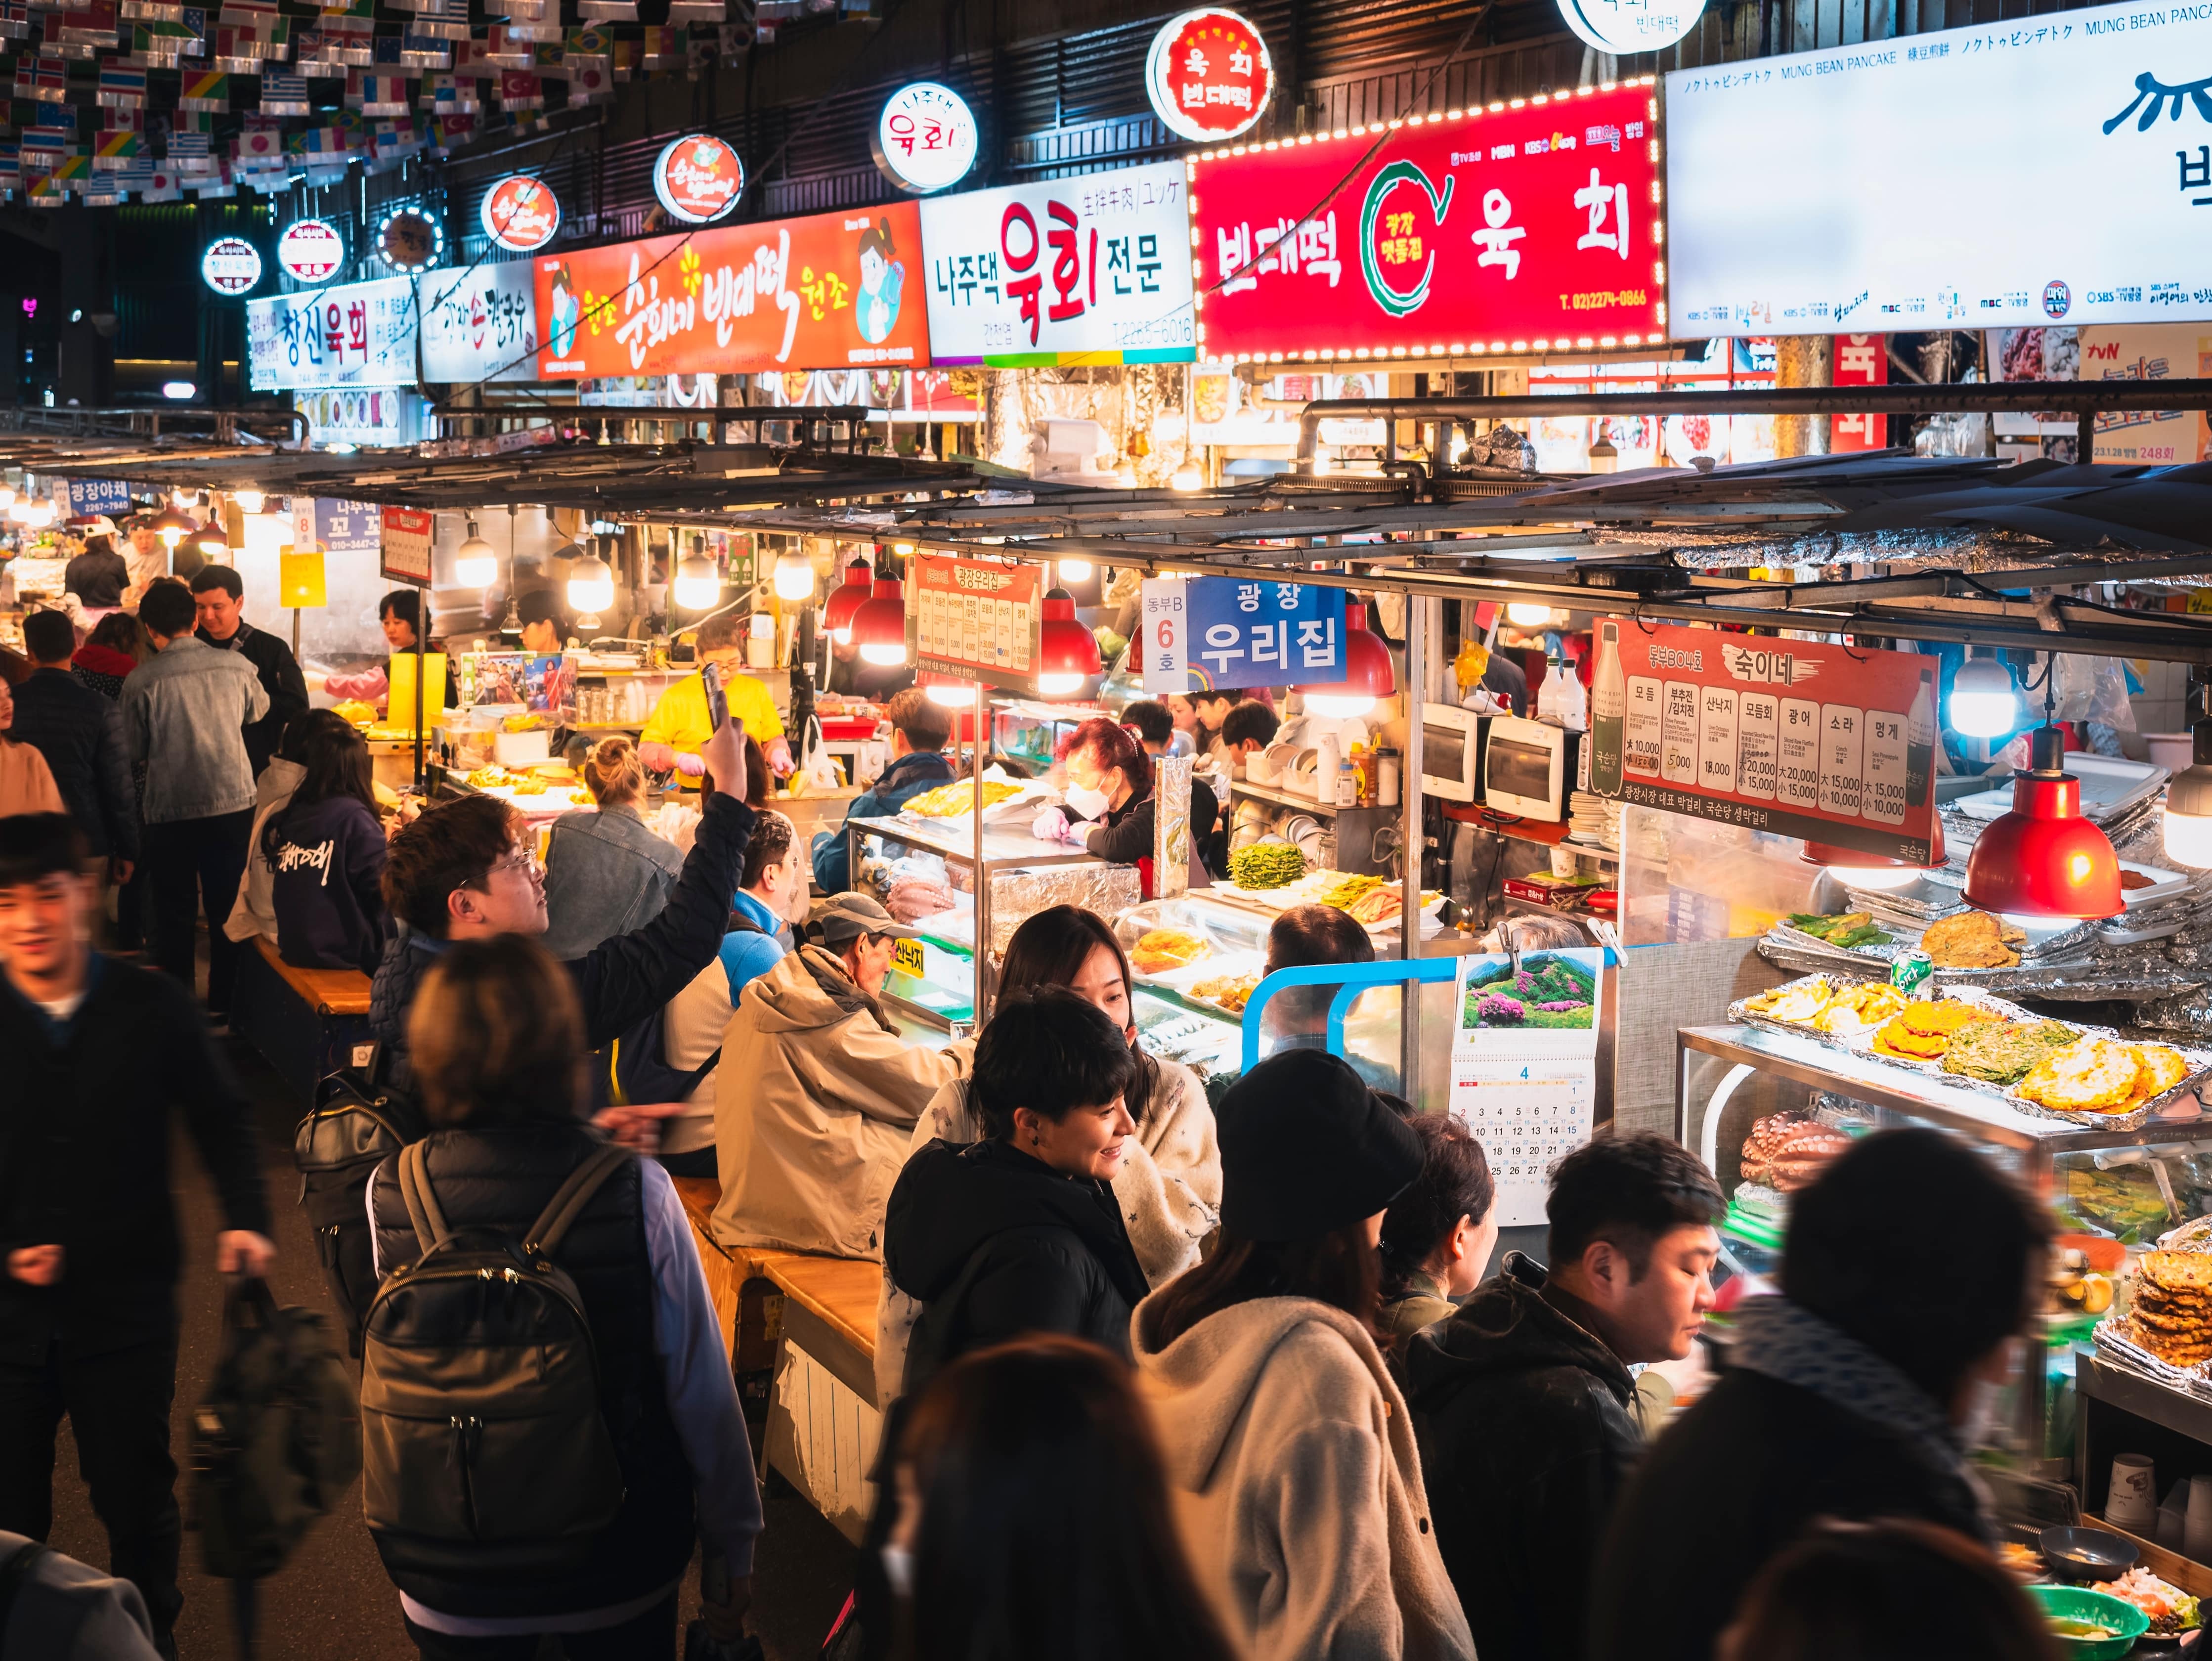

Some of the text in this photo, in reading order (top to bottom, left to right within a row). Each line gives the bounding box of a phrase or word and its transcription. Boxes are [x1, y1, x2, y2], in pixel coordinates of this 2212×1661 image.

[1636, 14, 1678, 34] 빈대떡
[2085, 11, 2166, 36] MUNG BEAN
[1184, 48, 1253, 77] 육 회
[1780, 50, 1897, 80] MUNG BEAN PANCAKE
[1182, 82, 1253, 112] 빈대떡
[889, 114, 954, 157] 육회
[1490, 144, 1516, 160] MBN
[1524, 140, 1542, 155] KBS
[1385, 212, 1416, 237] 광장
[1470, 167, 1630, 280] 육 회
[1217, 210, 1342, 297] 빈대떡
[935, 200, 1163, 347] 나주댁 육회 전문
[582, 229, 849, 370] 원조 순희네 빈대떡 원조
[1559, 289, 1647, 310] T. 02)2274-0866
[2097, 292, 2115, 303] SBS
[282, 300, 368, 367] 창신육회
[2087, 342, 2120, 360] tvN
[2140, 446, 2174, 461] 248회
[71, 480, 128, 502] 광장야채
[300, 518, 308, 532] 8
[958, 568, 998, 592] 광장우리집
[981, 604, 993, 614] 모듬회
[998, 606, 1010, 617] 산낙지
[1147, 596, 1182, 612] 동부B
[1017, 609, 1026, 619] 멍게
[1157, 619, 1174, 649] 6
[951, 639, 960, 649] 5,000
[965, 642, 976, 652] 4,000
[983, 639, 995, 650] 30,000
[1017, 646, 1029, 656] 15,000
[1201, 617, 1335, 673] 우리집
[1017, 656, 1029, 666] 10,000
[1159, 654, 1174, 671] 호
[1648, 645, 1792, 686] 동부B04호 숙이네
[1635, 686, 1654, 702] 모듬
[1670, 687, 1693, 703] 부추전
[1668, 701, 1694, 718] /김치전
[1706, 696, 1733, 715] 산낙지
[1745, 702, 1772, 721] 모듬회
[1788, 708, 1810, 727] 광어
[1830, 715, 1854, 734] 소라
[1875, 722, 1898, 740] 멍게
[1635, 740, 1659, 755] 10,000
[1879, 752, 1899, 761] Pineapple
[1596, 750, 1617, 767] 국순당
[1747, 759, 1775, 776] 20,000
[1748, 776, 1775, 792] 15,000
[1778, 766, 1817, 784] 大 20,000
[1820, 773, 1860, 791] 大 15,000
[1778, 782, 1816, 800] 小 15,000
[1820, 789, 1859, 808] 小 10,000
[1864, 781, 1905, 799] 大 15,000
[1624, 785, 1768, 827] 광장시장 대표 막걸리, 국순당 생막걸리
[1863, 797, 1904, 816] 小 10,000
[1900, 844, 1926, 862] 국순당
[896, 941, 924, 972] 산낙지
[1520, 1066, 1529, 1080] 4
[1572, 1087, 1576, 1095] 1
[1460, 1108, 1466, 1117] 2
[1479, 1108, 1484, 1116] 3
[1534, 1107, 1540, 1115] 6
[1475, 1128, 1485, 1136] 10
[1513, 1127, 1522, 1136] 12
[1531, 1127, 1541, 1135] 13
[1549, 1126, 1559, 1135] 14
[1492, 1147, 1503, 1155] 18
[1547, 1146, 1557, 1154] 21
